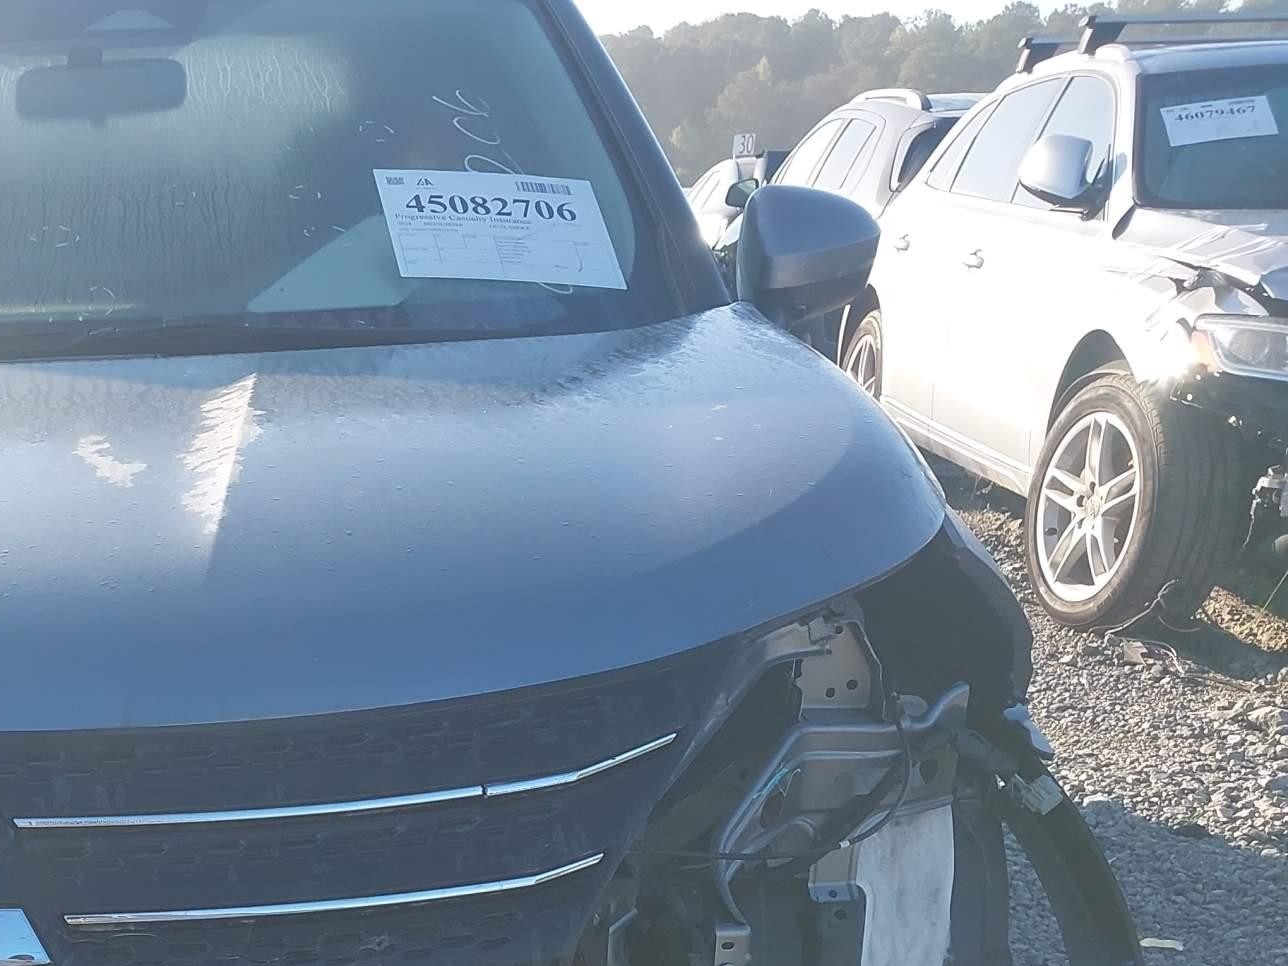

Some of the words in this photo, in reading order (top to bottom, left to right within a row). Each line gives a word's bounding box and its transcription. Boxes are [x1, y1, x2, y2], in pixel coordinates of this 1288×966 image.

[738, 135, 753, 154] 30
[405, 194, 577, 222] 45082706
[395, 213, 445, 222] Progressive
[449, 215, 487, 223] Casualty
[490, 216, 532, 225] Insurance
